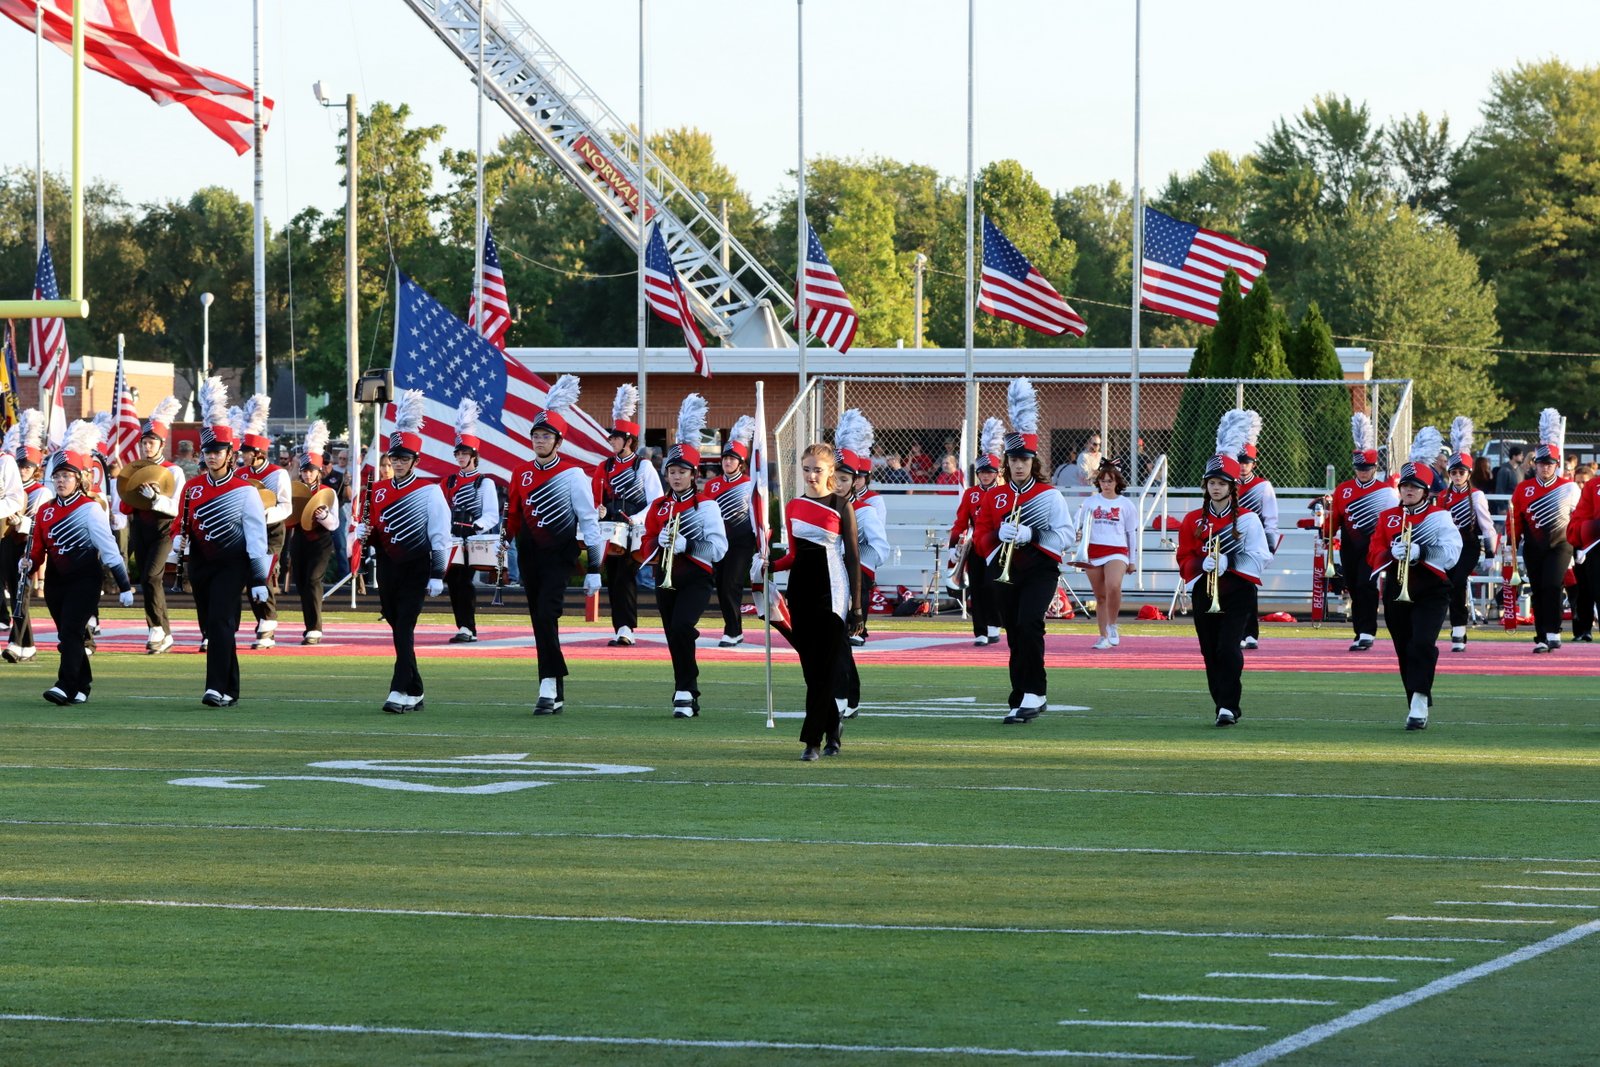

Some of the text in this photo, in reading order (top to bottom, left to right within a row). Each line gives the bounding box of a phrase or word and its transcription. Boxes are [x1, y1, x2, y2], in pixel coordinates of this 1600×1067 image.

[521, 471, 534, 486] B
[190, 485, 203, 499] B
[375, 488, 387, 503] B
[1342, 487, 1353, 499] B
[995, 493, 1008, 509] B
[43, 507, 55, 521] B
[1387, 515, 1401, 528] B
[1313, 567, 1323, 609] BELLEVUE
